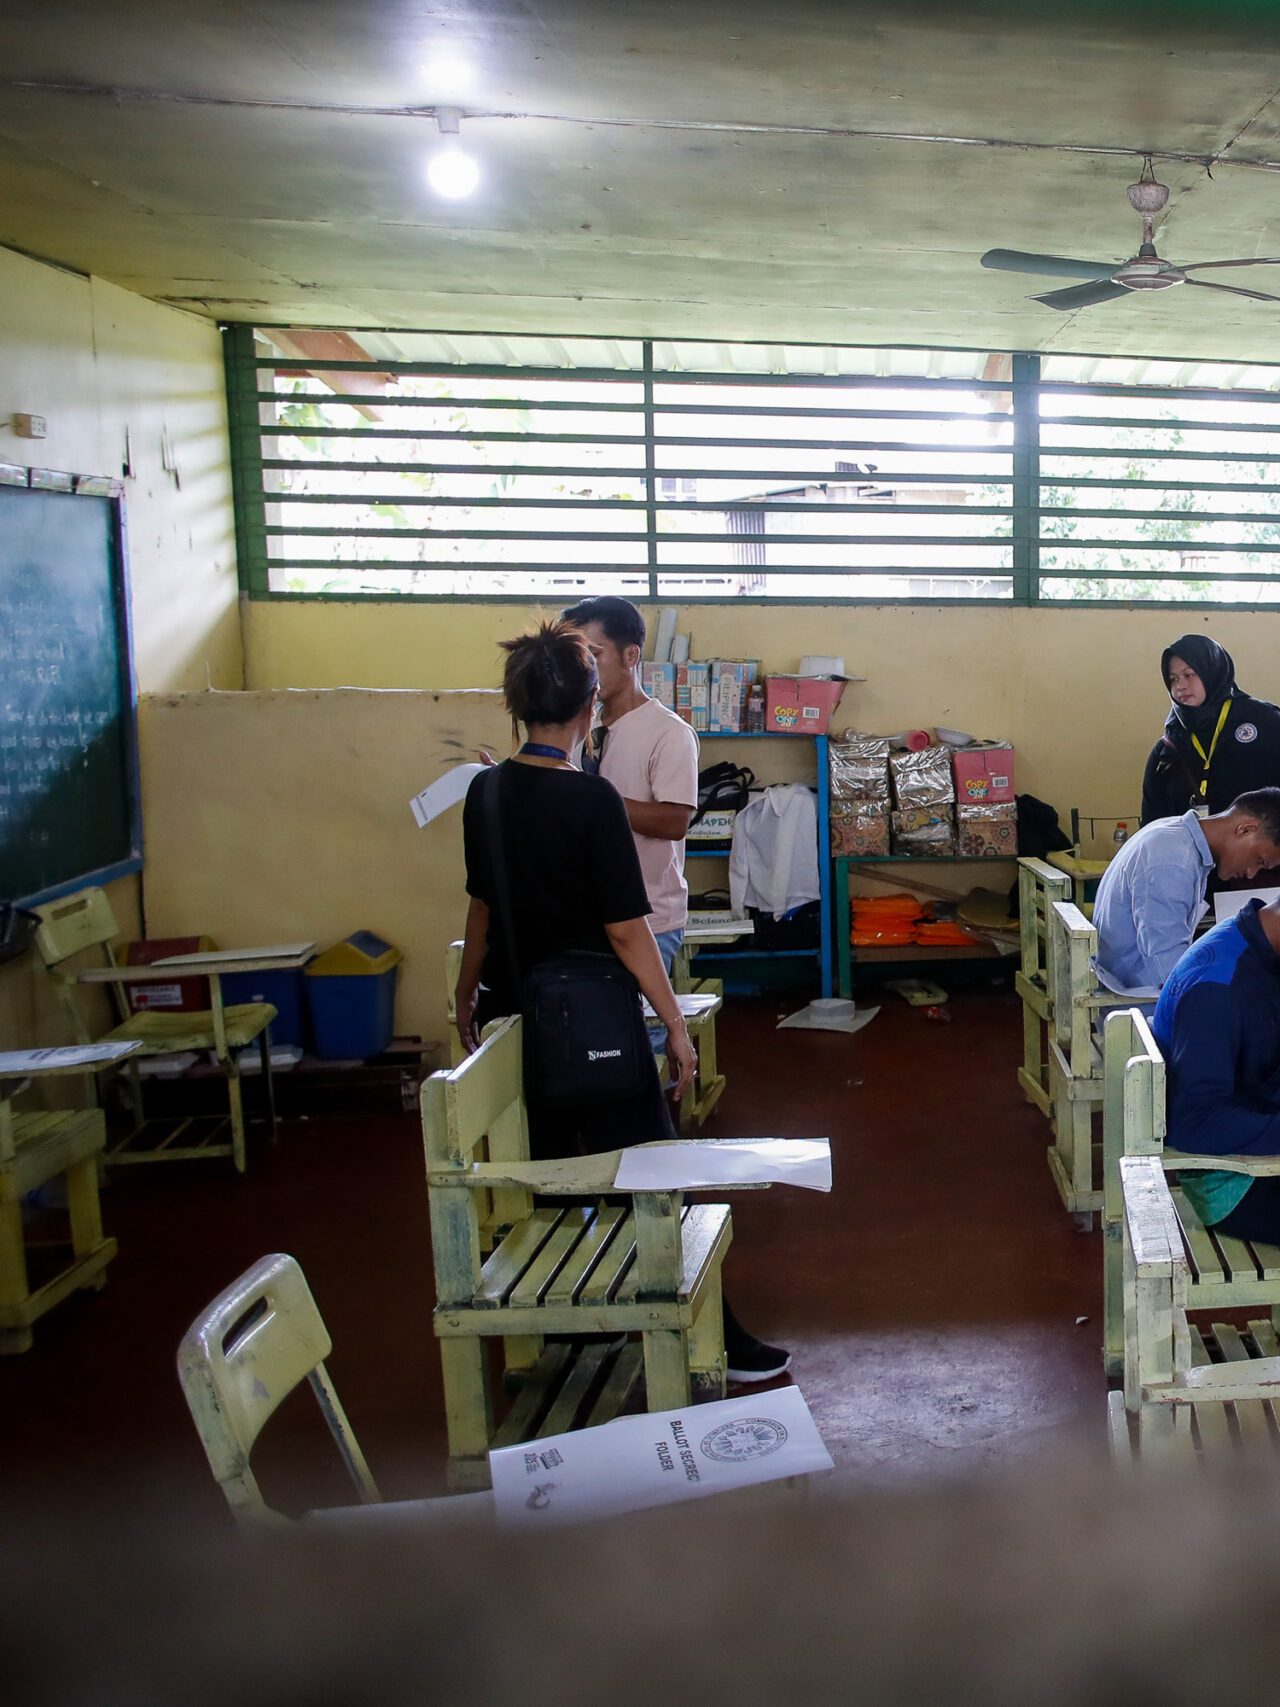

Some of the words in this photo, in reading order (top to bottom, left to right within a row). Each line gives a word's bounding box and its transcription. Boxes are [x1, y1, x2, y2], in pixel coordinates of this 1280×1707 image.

[775, 705, 799, 717] COPY
[965, 779, 988, 789] COPY
[596, 1049, 621, 1058] FASHION
[655, 1441, 674, 1471] FOLDER
[670, 1420, 690, 1449] BALLOT
[680, 1450, 701, 1482] SECREC
